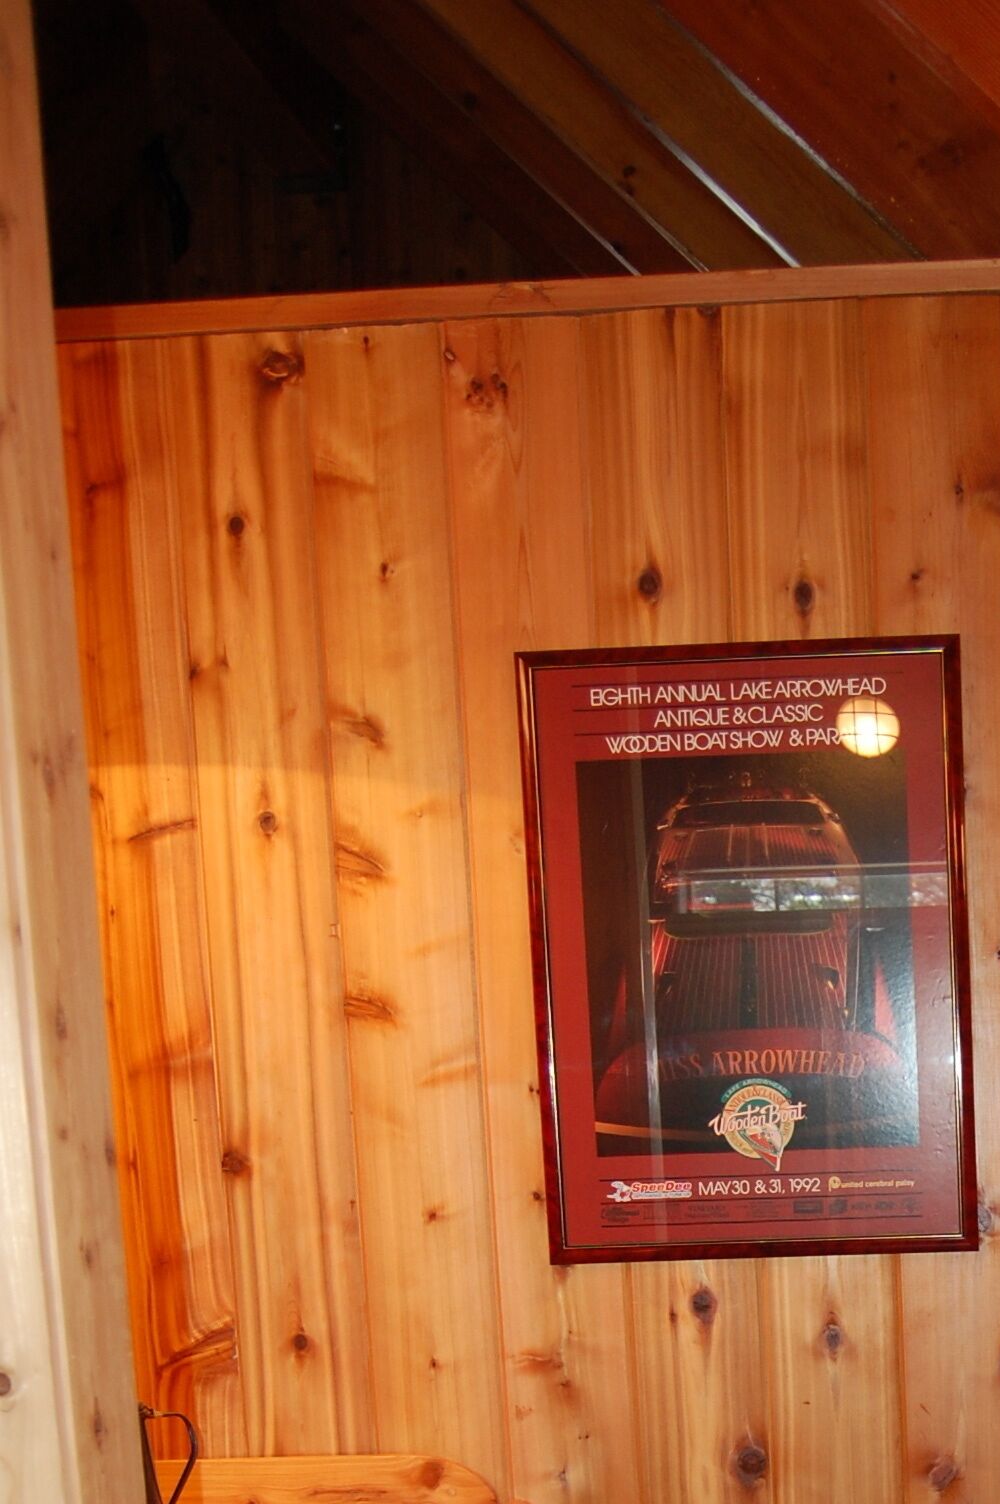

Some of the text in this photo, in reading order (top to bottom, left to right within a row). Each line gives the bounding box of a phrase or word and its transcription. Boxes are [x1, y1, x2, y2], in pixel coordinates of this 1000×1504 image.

[590, 677, 887, 706] EIGHTH ANNUAL LAKE ARROWHEAD
[654, 704, 824, 728] ANTIQUE & CLASSIC
[605, 734, 681, 754] WOODEN
[684, 731, 729, 751] BOAT
[730, 729, 784, 749] SHOW
[789, 728, 804, 747] &
[712, 1049, 865, 1078] ARROWHEAD
[708, 1104, 766, 1136] Wooden
[760, 1101, 807, 1124] Boat
[699, 1181, 732, 1195] MAY
[731, 1180, 750, 1195] 30
[755, 1179, 766, 1194] &
[769, 1178, 785, 1194] 31,
[789, 1177, 821, 1193] 1992
[840, 1180, 864, 1188] united
